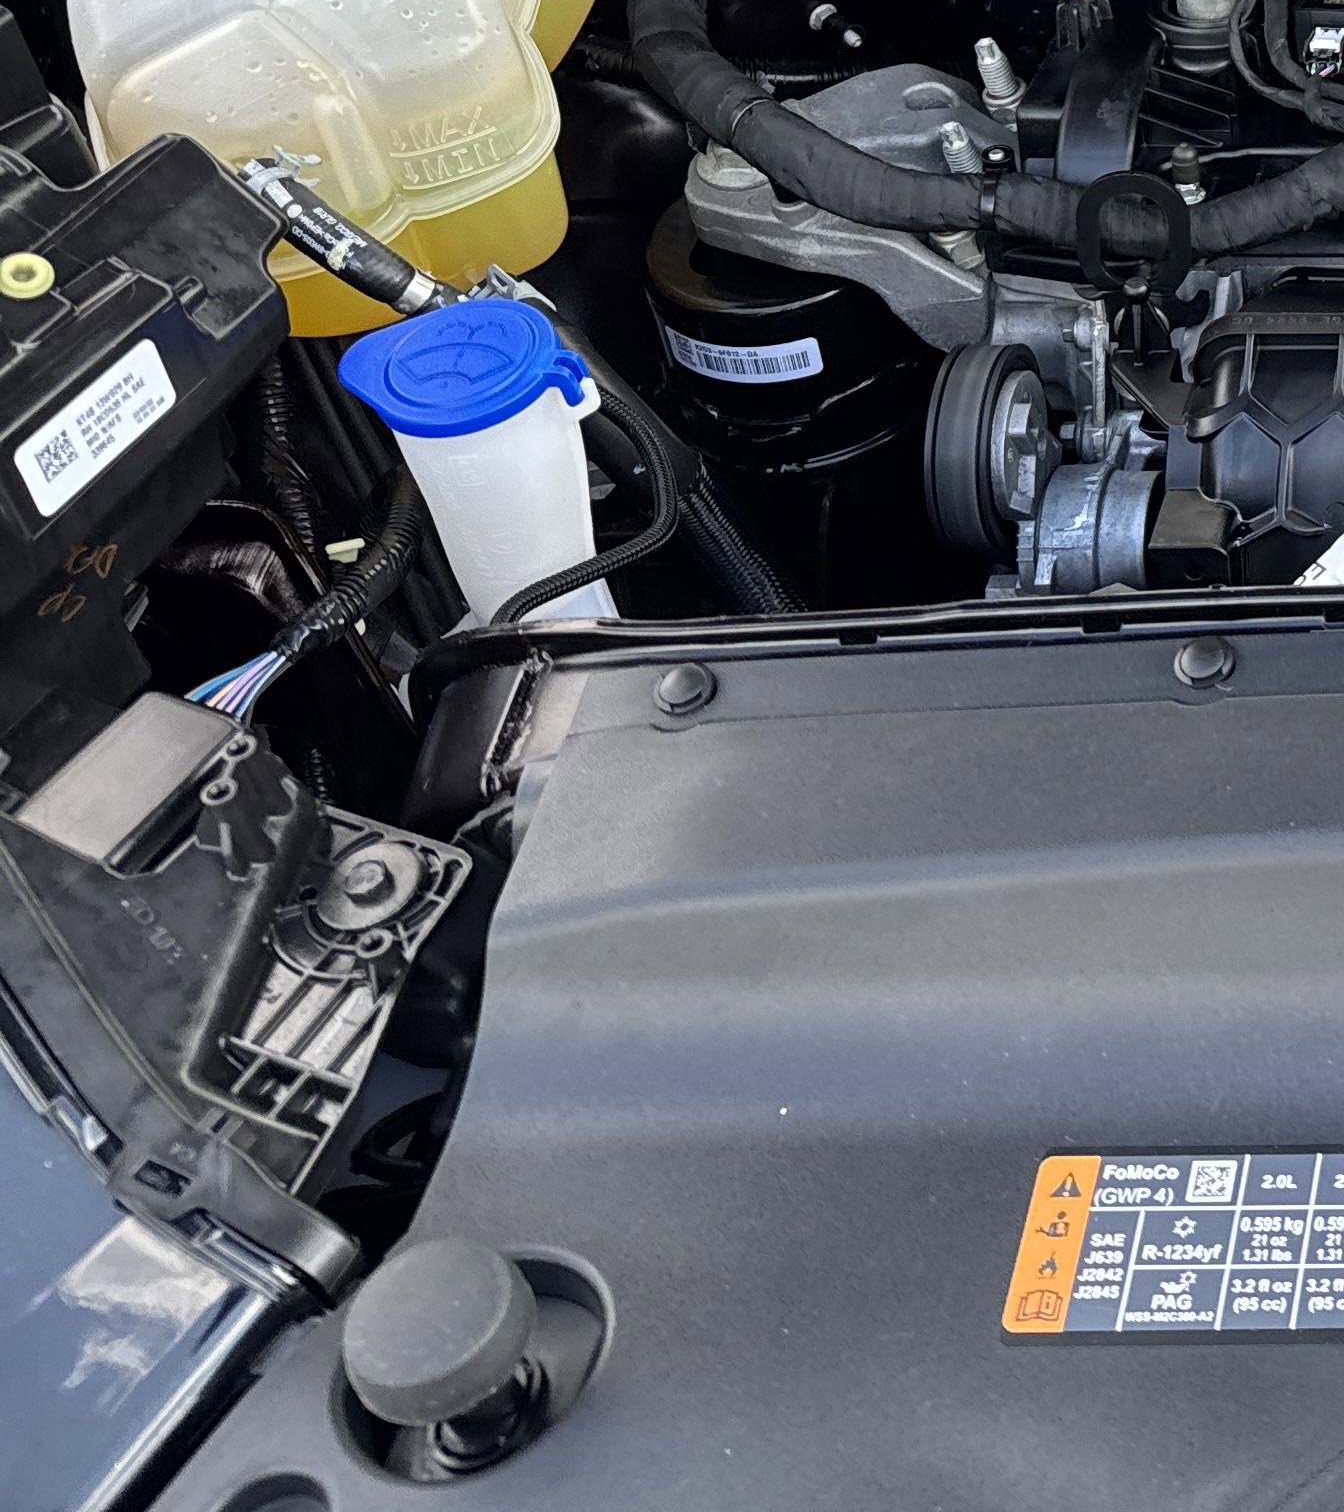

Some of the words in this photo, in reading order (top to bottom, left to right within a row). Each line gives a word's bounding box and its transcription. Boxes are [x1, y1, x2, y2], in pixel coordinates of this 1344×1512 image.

[408, 106, 490, 150] MAX
[421, 136, 501, 183] MIN
[1102, 1164, 1180, 1180] FoMoCo
[1260, 1174, 1298, 1189] 2.0L
[1094, 1187, 1152, 1207] (GWP
[1153, 1187, 1174, 1207] 4)
[1239, 1216, 1282, 1232] 0.595
[1283, 1216, 1304, 1235] kg
[1089, 1233, 1126, 1248] SAE
[1250, 1234, 1269, 1247] 21
[1270, 1235, 1288, 1247] oz
[1324, 1234, 1343, 1247] 21
[1084, 1250, 1124, 1264] J639
[1141, 1244, 1223, 1263] R-1234yf
[1242, 1248, 1269, 1262] 1.31
[1270, 1249, 1293, 1262] lbs
[1316, 1248, 1343, 1261] 1.31
[1230, 1278, 1256, 1293] 3.2
[1272, 1280, 1293, 1293] oz
[1305, 1278, 1331, 1293] 3.2
[1150, 1294, 1193, 1310] PAG
[1232, 1297, 1259, 1314] (95
[1260, 1296, 1287, 1314] cc)
[1308, 1296, 1335, 1314] (95
